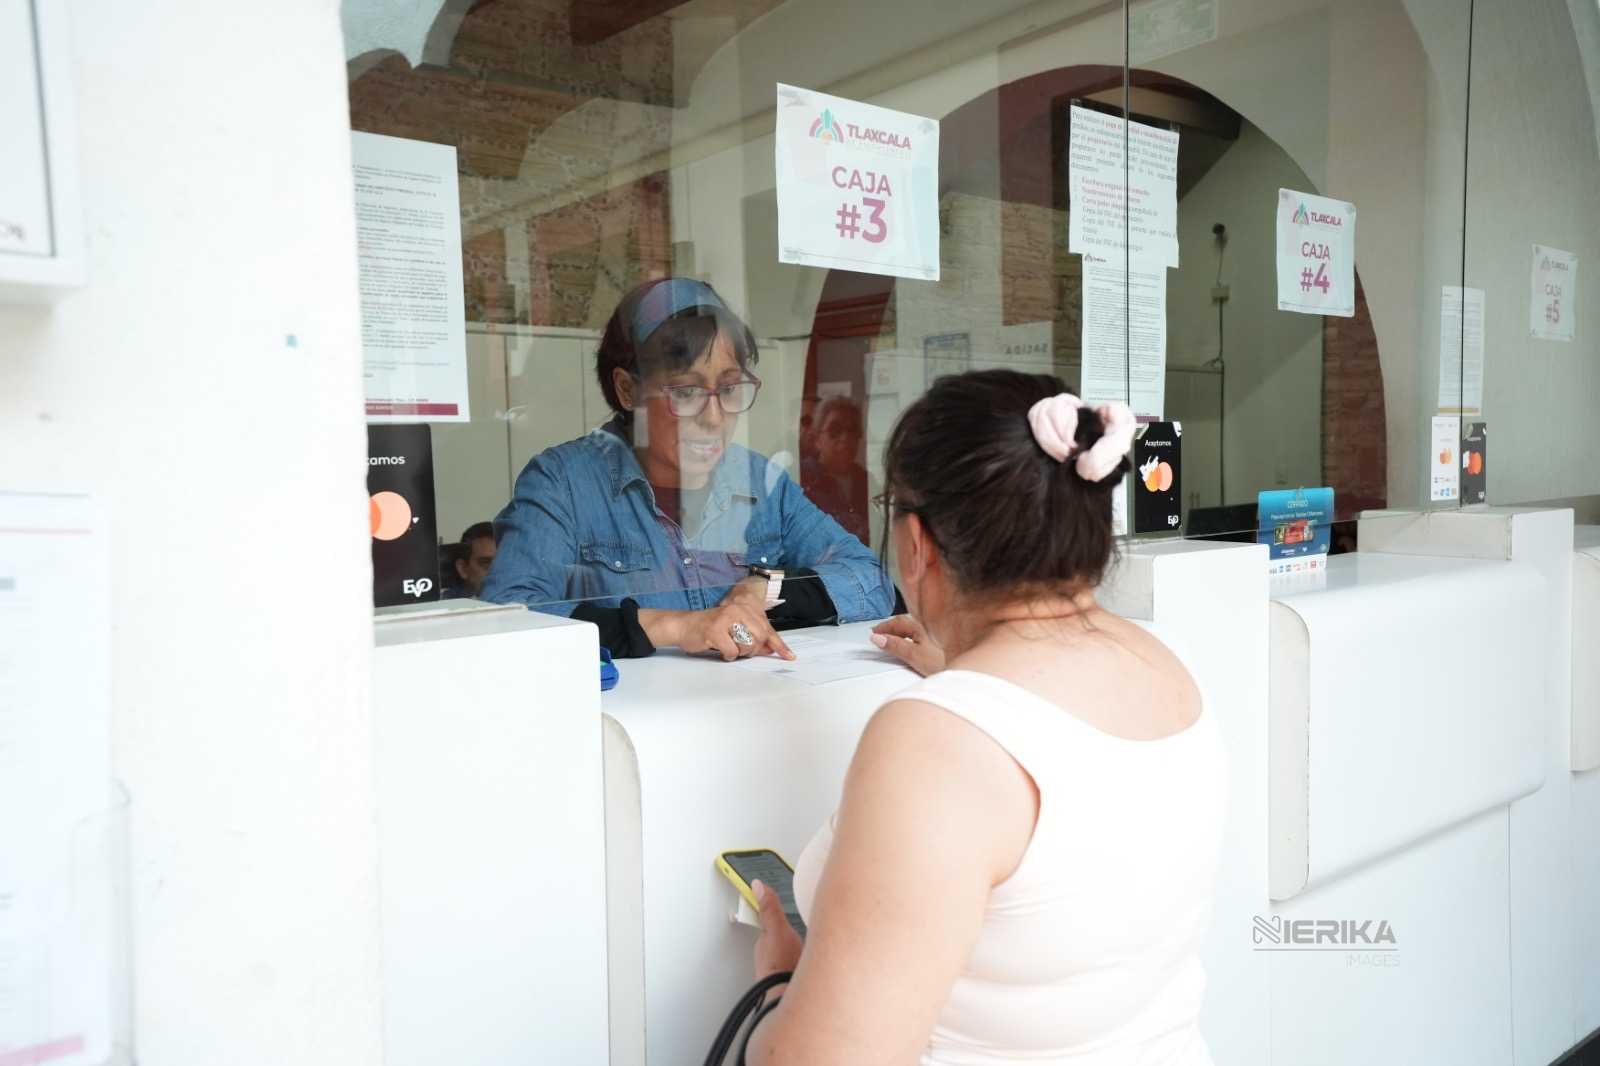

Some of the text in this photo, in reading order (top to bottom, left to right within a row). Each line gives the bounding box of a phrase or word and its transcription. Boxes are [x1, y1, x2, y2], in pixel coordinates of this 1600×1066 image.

[847, 124, 912, 150] TLAXCALA
[832, 165, 892, 197] CAJA
[835, 197, 887, 243] #3
[1311, 212, 1342, 226] TLAXCALA
[1301, 241, 1331, 260] CAJA
[1300, 262, 1331, 294] #4
